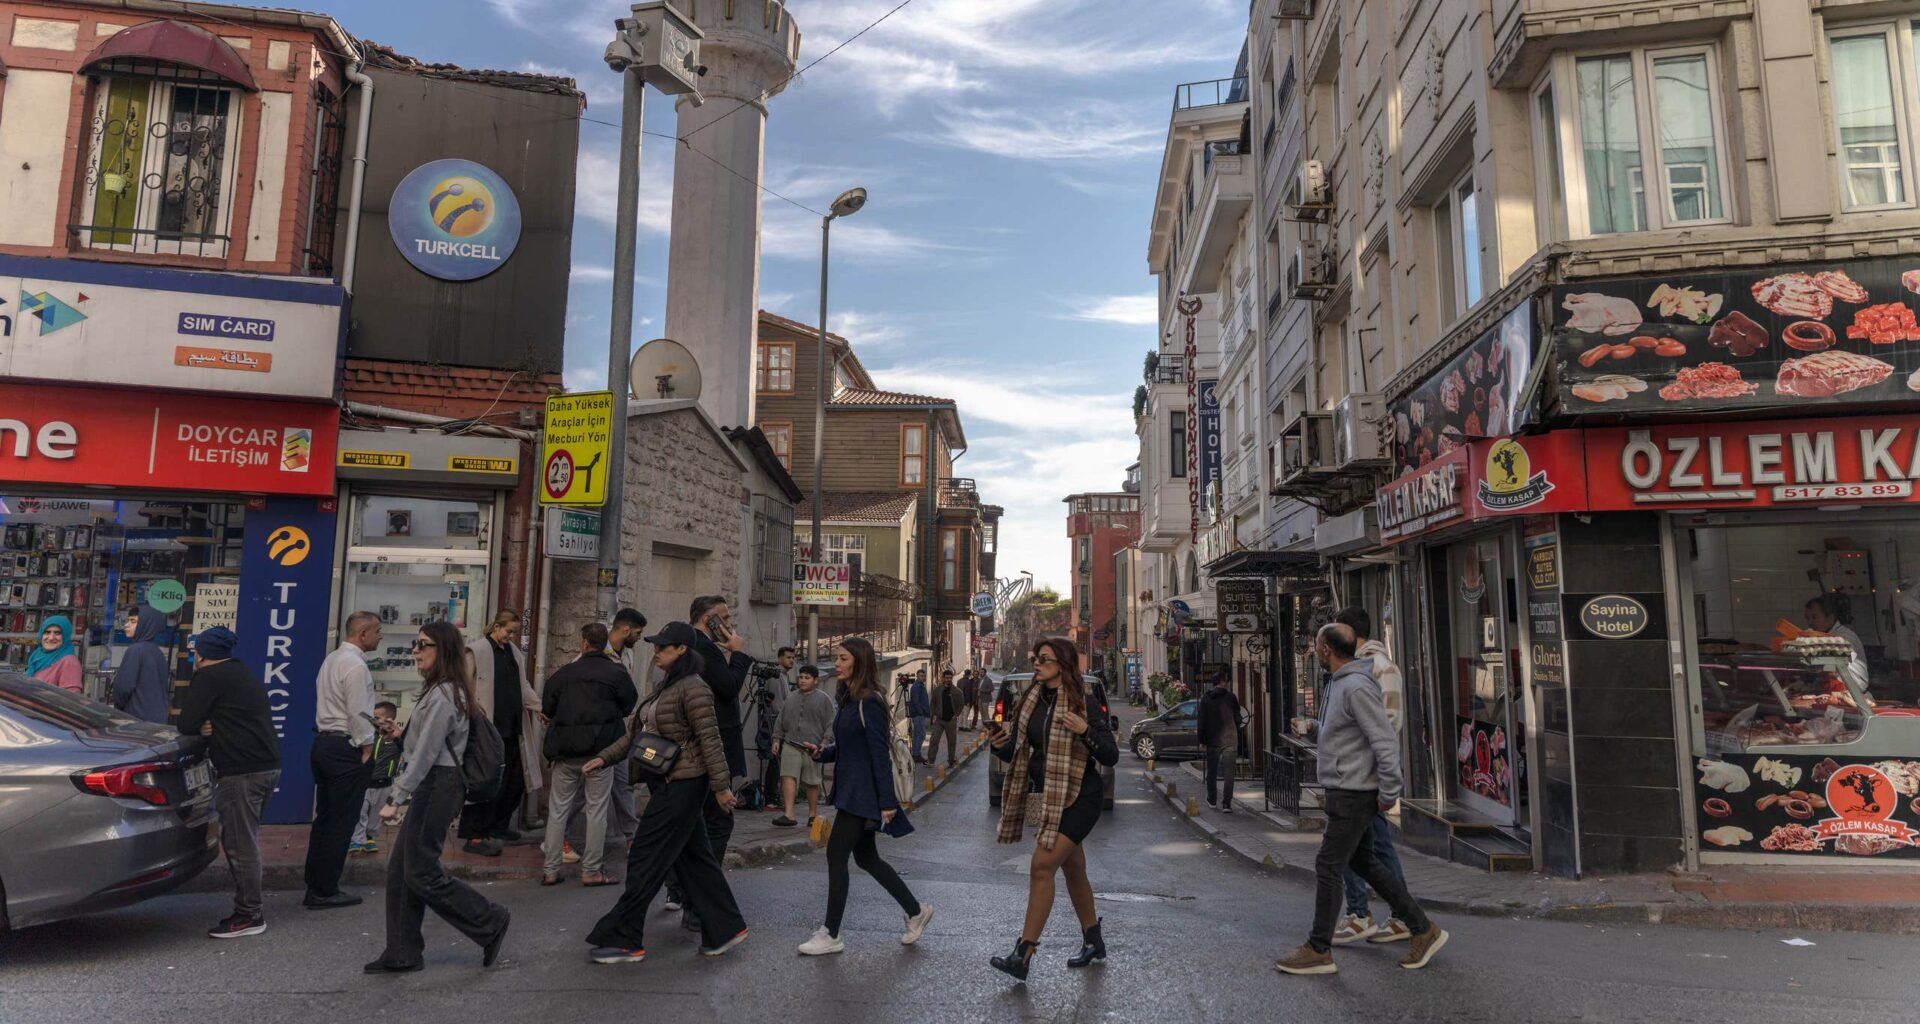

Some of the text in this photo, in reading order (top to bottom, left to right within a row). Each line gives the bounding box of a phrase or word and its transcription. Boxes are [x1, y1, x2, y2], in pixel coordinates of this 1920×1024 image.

[415, 238, 500, 260] TURKCELL
[183, 316, 271, 336] SIM CARD
[550, 398, 611, 412] Daha Yüksek
[551, 412, 606, 430] Araçlar İçin
[177, 423, 278, 446] DOYCAR
[548, 431, 606, 444] Mecburi Yön
[1184, 317, 1200, 545] KUMLUK KONAK HOTEL
[188, 445, 269, 467] İLETİŞİM
[1621, 427, 1920, 489] ÖZLEM K
[1411, 463, 1456, 516] KASAP
[1784, 484, 1901, 498] 517 83 89
[1486, 490, 1534, 505] ÖZLEM KASAP
[42, 501, 90, 511] HUAWEI
[561, 515, 588, 533] Avrasya
[806, 566, 836, 582] WC
[198, 588, 239, 597] TRAVEL
[799, 582, 840, 590] TOILET
[161, 590, 183, 601] Kliq
[1225, 593, 1257, 602] SUITES
[1220, 603, 1263, 613] OLD CITY
[1590, 604, 1638, 618] Sayina
[1596, 620, 1633, 632] Hotel
[1533, 644, 1562, 667] Gloria
[1829, 821, 1897, 834] ÖZLEM KASAP
